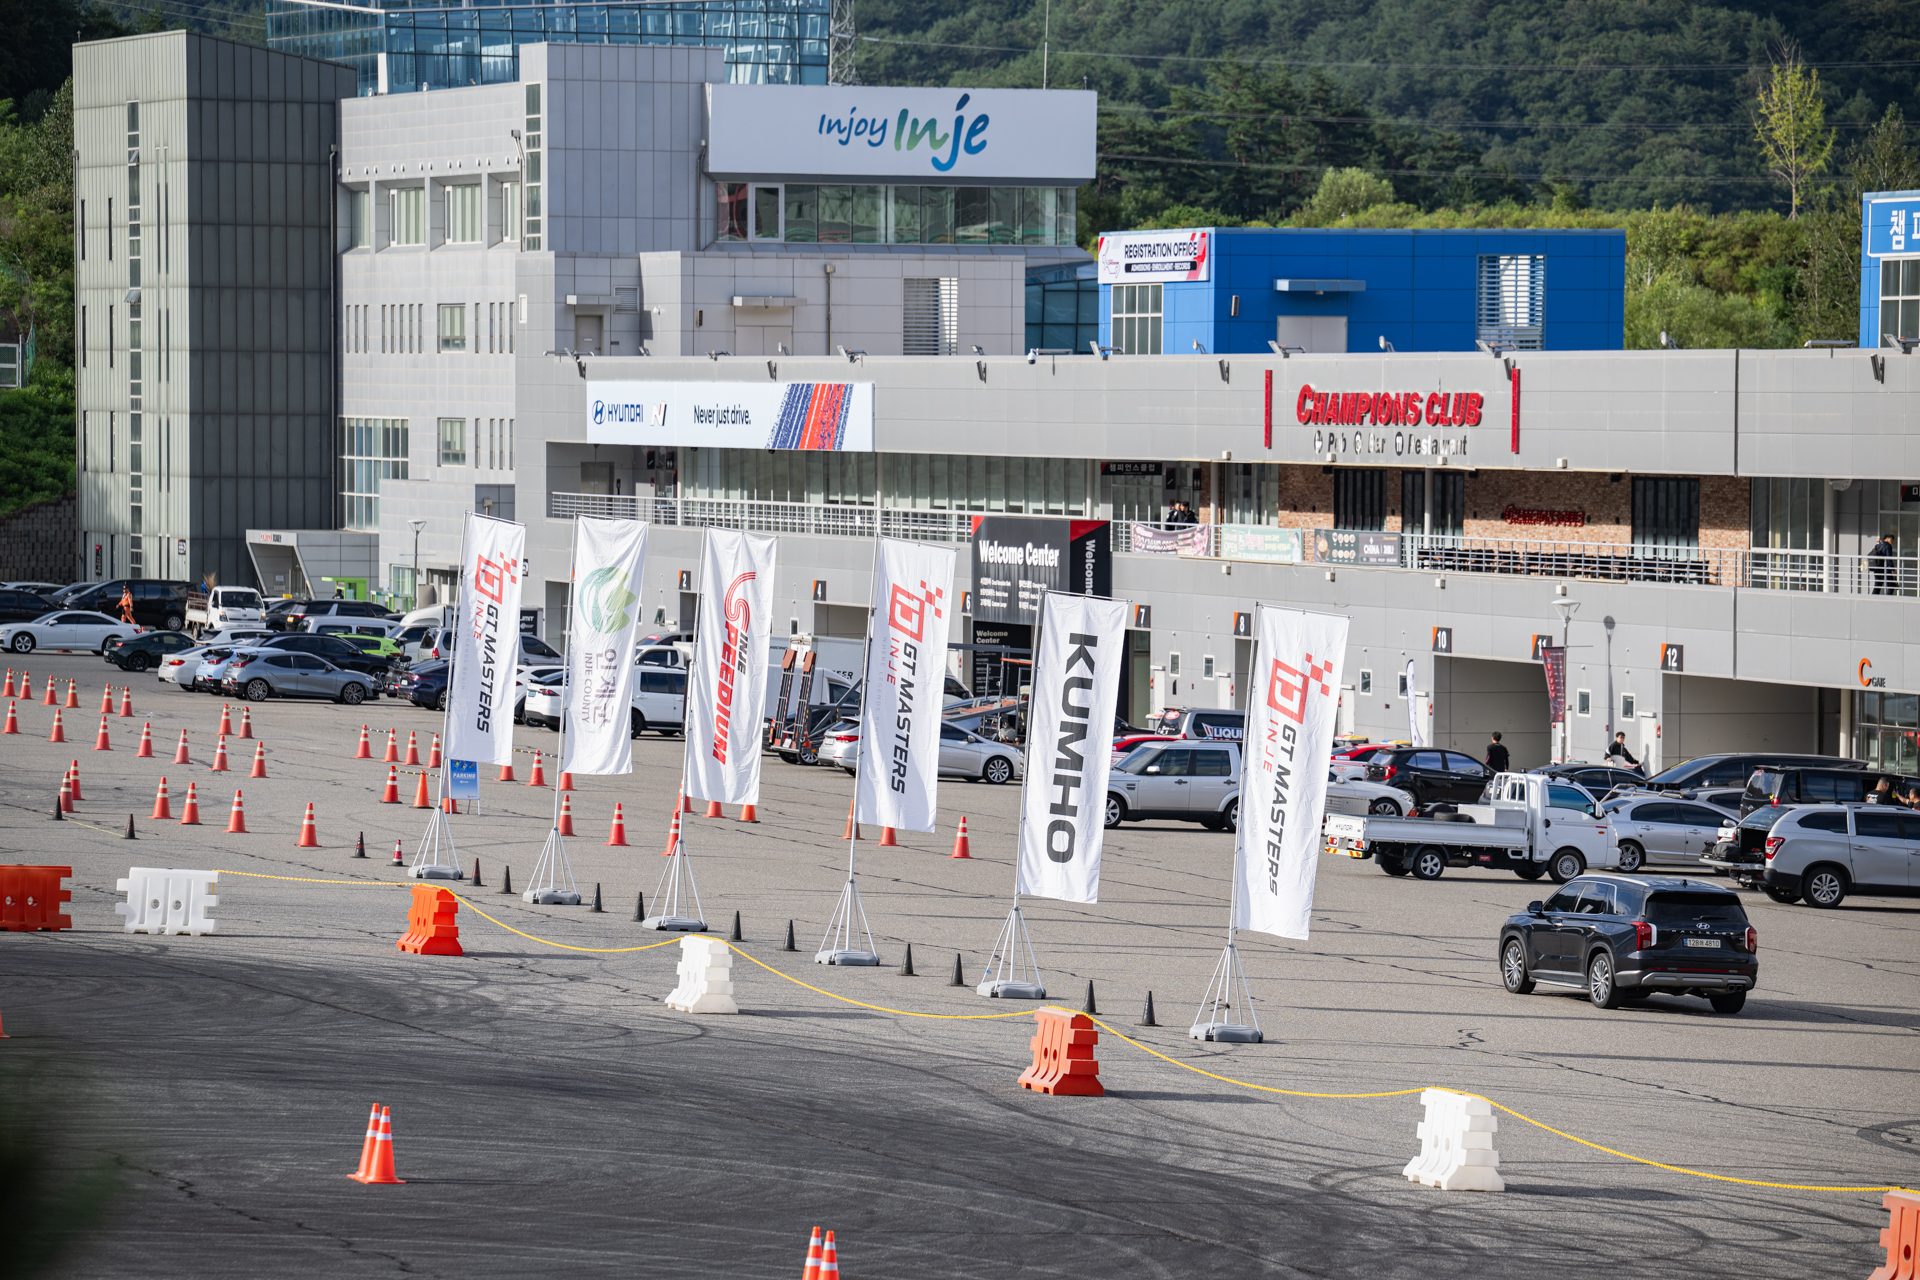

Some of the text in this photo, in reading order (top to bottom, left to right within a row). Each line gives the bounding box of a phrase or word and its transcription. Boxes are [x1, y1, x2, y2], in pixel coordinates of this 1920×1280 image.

[818, 93, 990, 172] Injoy Inje
[1124, 241, 1198, 259] REGISTRATION OFFICE
[607, 403, 644, 423] HYUNDAI
[693, 404, 751, 428] Never just drive.
[1296, 383, 1485, 427] CHAMPIONS CLUB
[1109, 463, 1155, 472] 챔피언스클럽
[979, 540, 1060, 567] Welcome Center
[1085, 539, 1096, 596] Welcome
[682, 573, 687, 588] 2
[817, 583, 822, 599] 4
[966, 594, 971, 610] 6
[1139, 608, 1146, 625] 7
[472, 600, 485, 640] INJE
[1239, 615, 1245, 633] 8
[737, 632, 748, 676] INJE
[1437, 630, 1447, 649] 10
[476, 604, 499, 733] GT MASTERS
[712, 571, 757, 765] SPEEDIUM
[886, 636, 900, 686] INJE
[1666, 647, 1678, 668] 12
[1857, 657, 1886, 688] C GATE
[580, 652, 593, 724] INJE COUNTY
[890, 641, 918, 795] GT MASTERS
[1213, 728, 1243, 739] LIQUI
[1046, 632, 1098, 863] KUMHO
[1263, 718, 1279, 774] INJE
[1266, 723, 1297, 896] GT MASTERS
